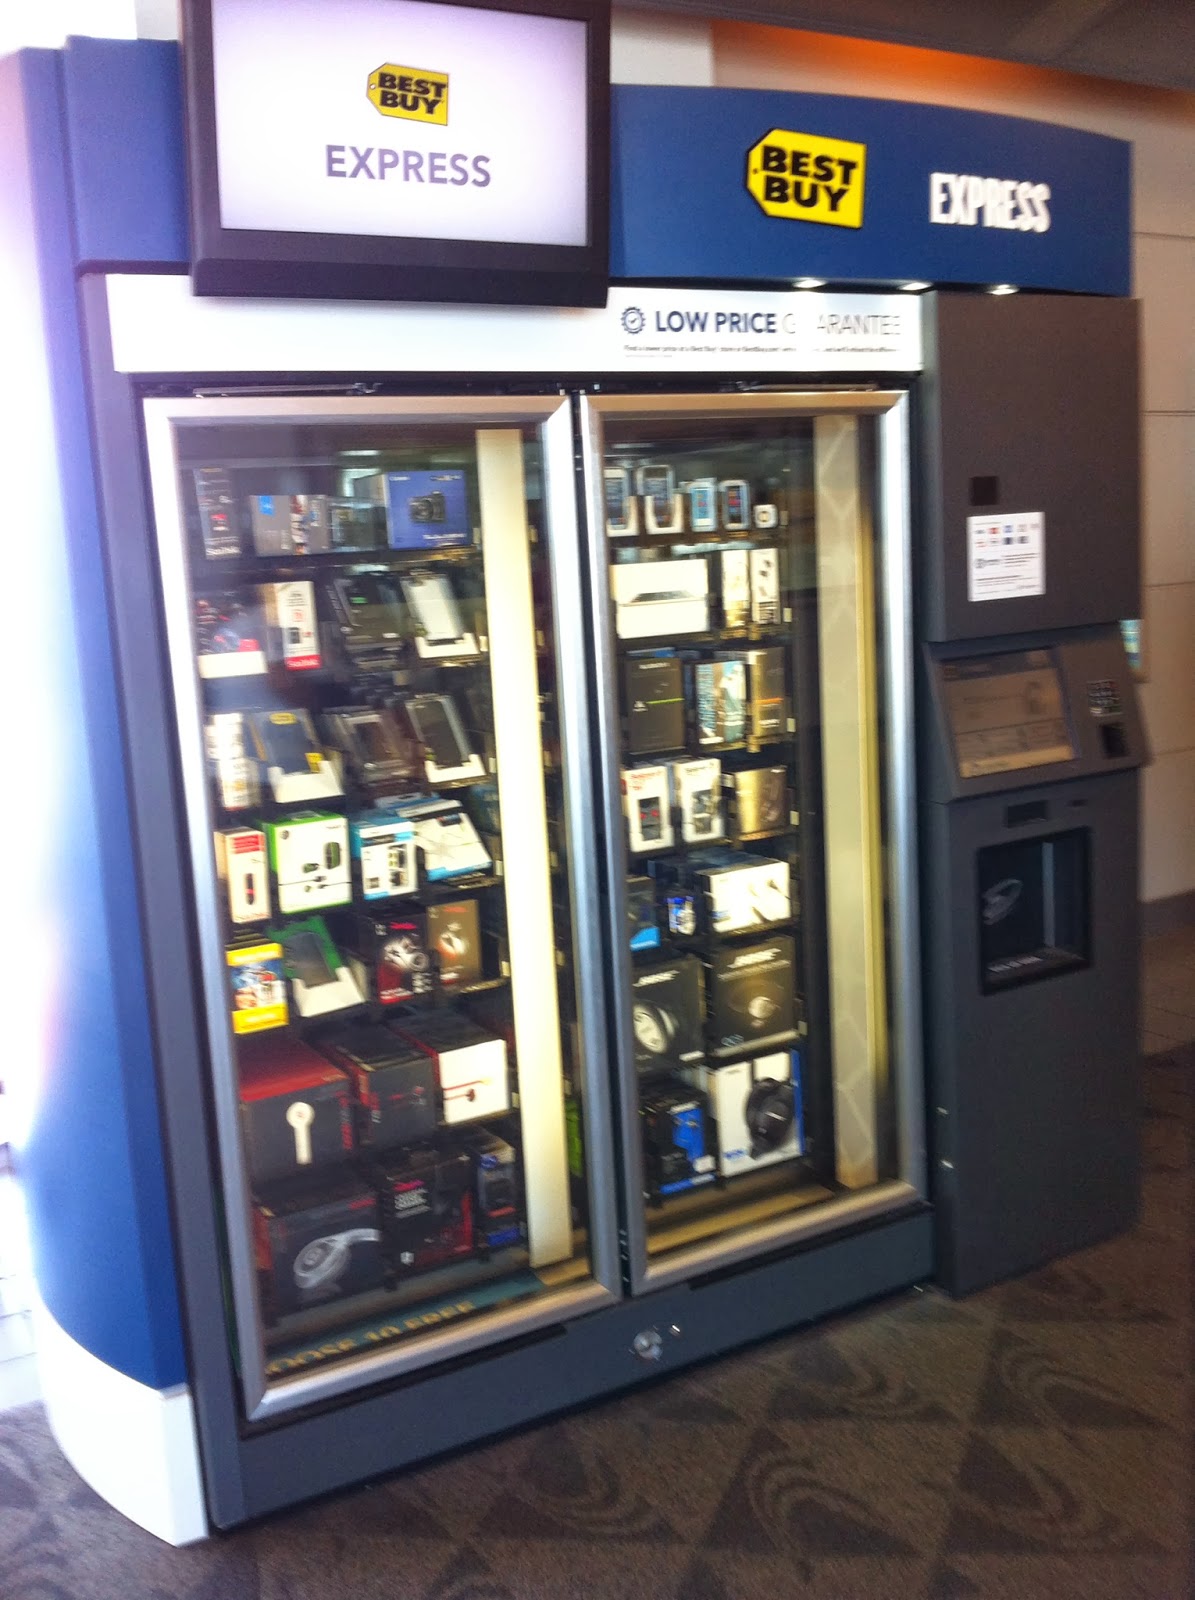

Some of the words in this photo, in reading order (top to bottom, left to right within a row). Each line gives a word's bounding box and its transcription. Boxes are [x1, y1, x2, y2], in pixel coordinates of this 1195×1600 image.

[378, 72, 448, 98] BEST
[379, 91, 443, 115] BUY
[326, 144, 492, 188] EXPRESS
[761, 145, 857, 185] BEST
[764, 175, 849, 212] BUY
[930, 172, 1050, 233] EXPRESS
[655, 310, 708, 333] LOW
[715, 312, 777, 334] PRICE
[782, 313, 901, 336] GARANTEE
